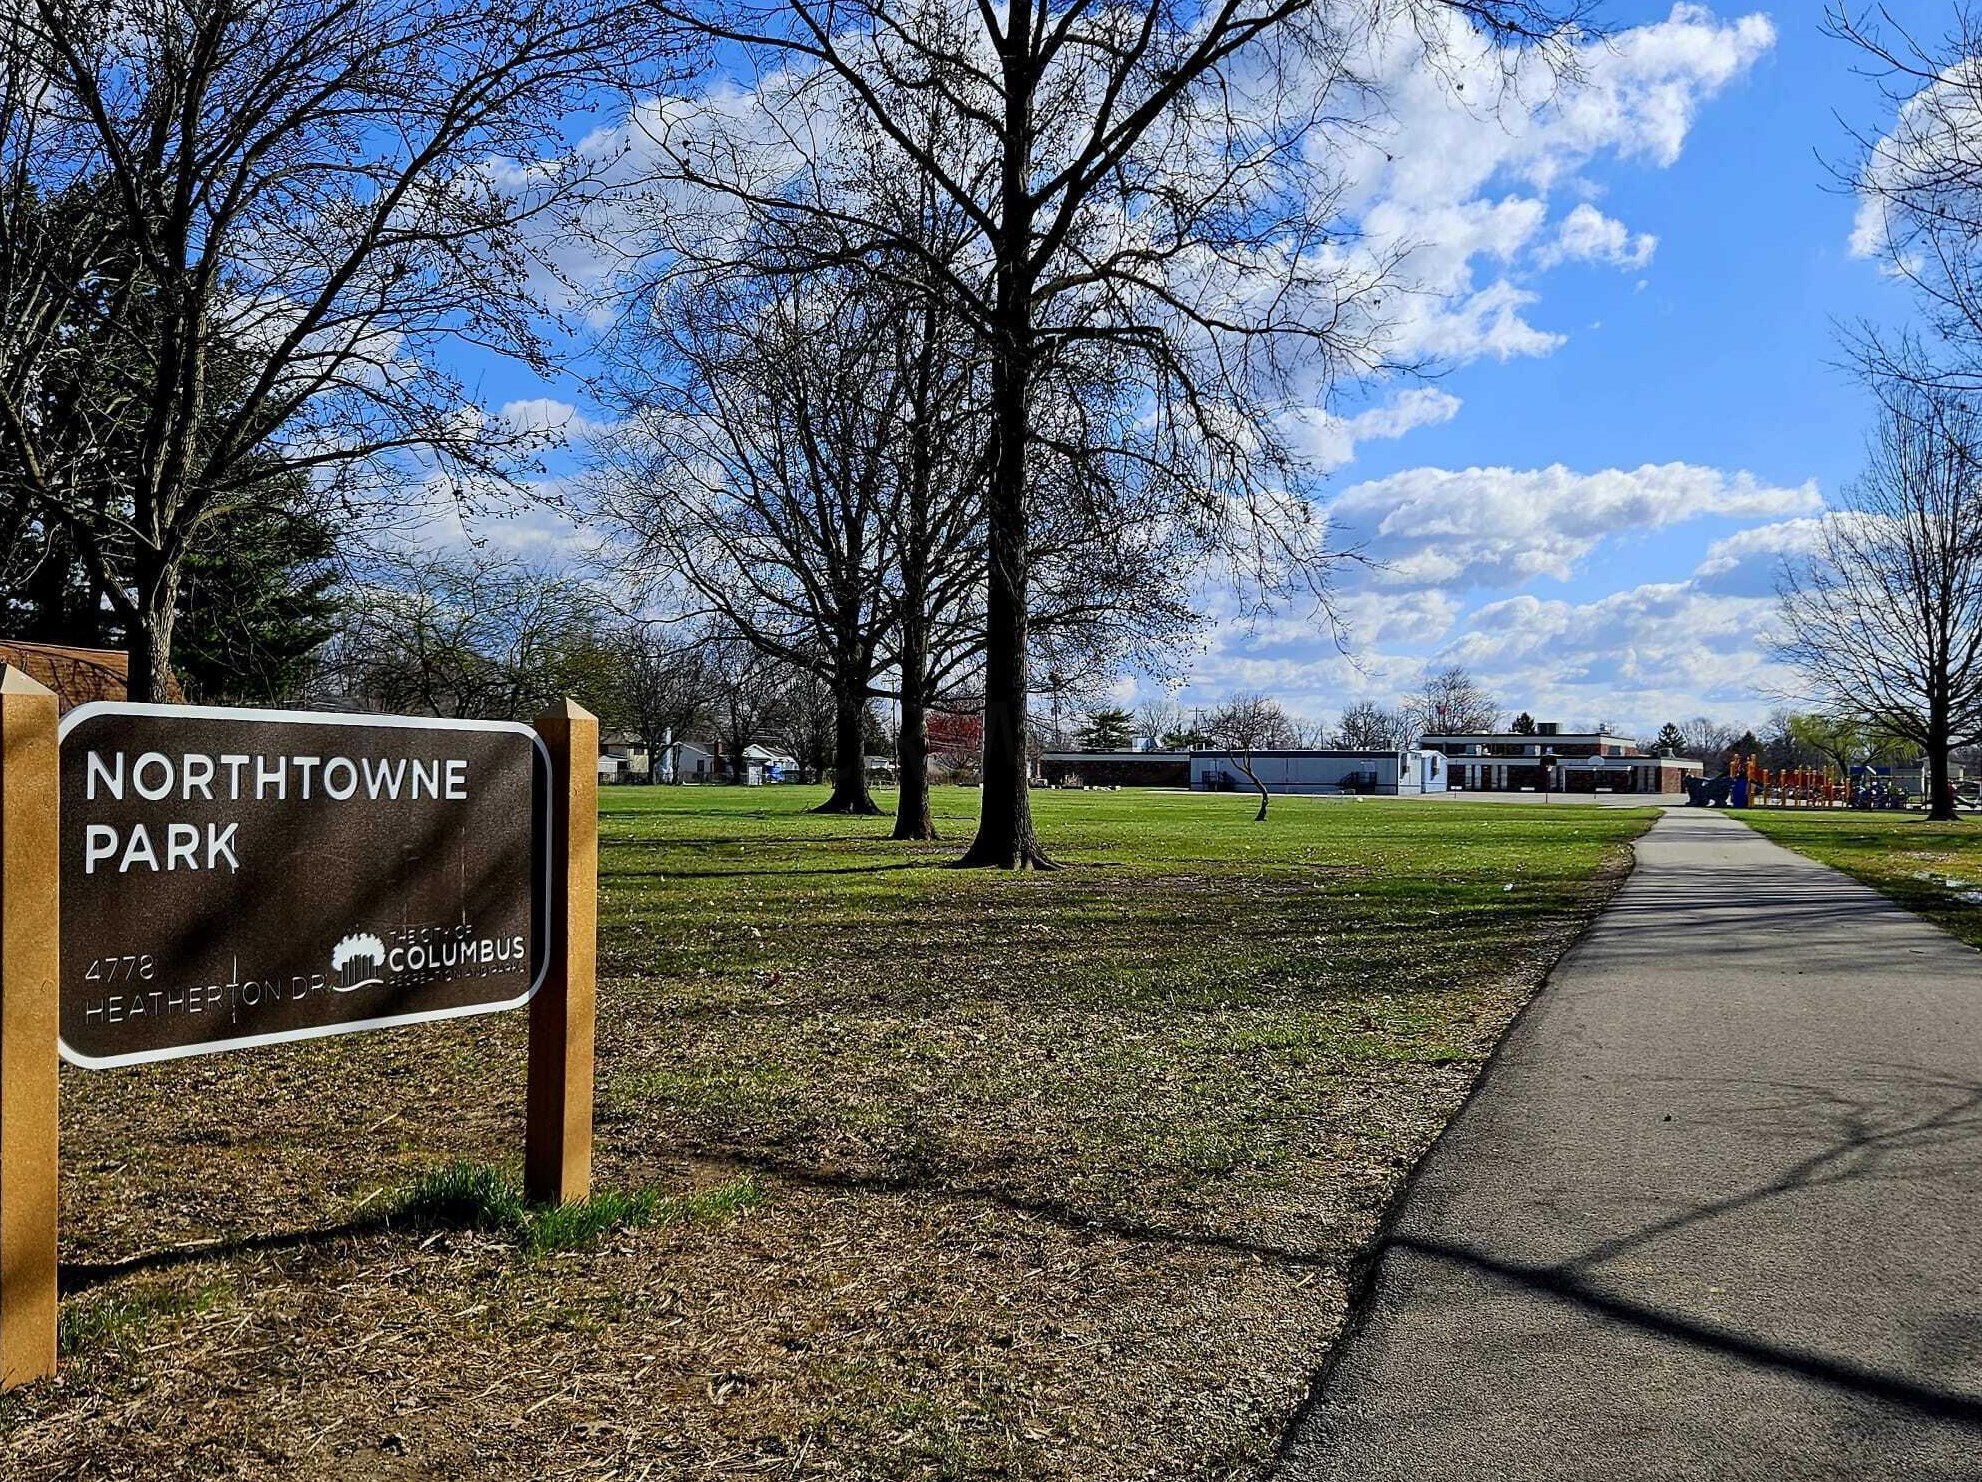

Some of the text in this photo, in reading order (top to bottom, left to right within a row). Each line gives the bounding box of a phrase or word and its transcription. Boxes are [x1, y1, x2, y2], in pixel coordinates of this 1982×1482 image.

[87, 750, 469, 800] NORTHTOWNE
[86, 822, 240, 874] PARK
[389, 924, 472, 945] THE CITY OF
[389, 936, 525, 972] COLUMBUS
[85, 954, 155, 983] 4778
[86, 979, 281, 1024] HEATHERTON
